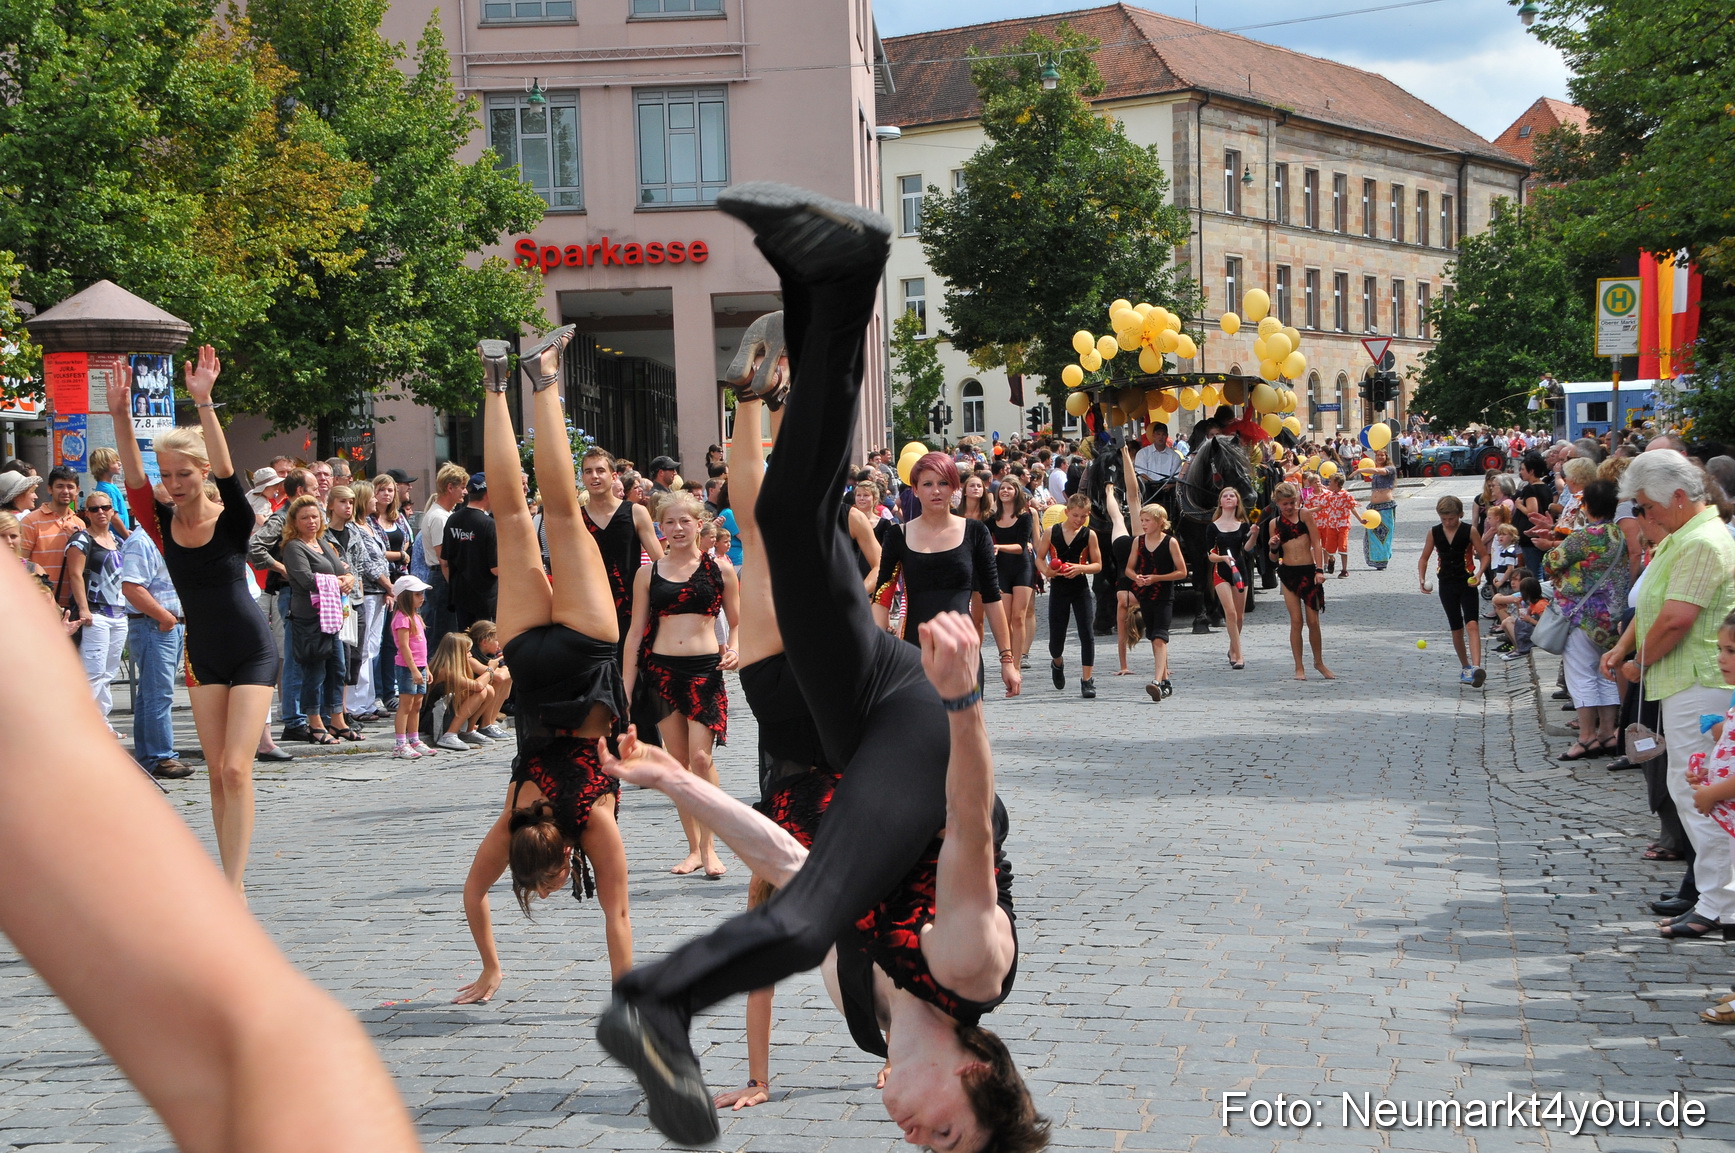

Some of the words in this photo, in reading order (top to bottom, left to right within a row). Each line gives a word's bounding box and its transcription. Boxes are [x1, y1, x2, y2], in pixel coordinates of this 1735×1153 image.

[514, 237, 709, 274] Sparkasse
[1611, 291, 1627, 309] H
[134, 418, 155, 428] 7.8.
[332, 435, 371, 444] Ticketshp
[450, 527, 475, 541] West
